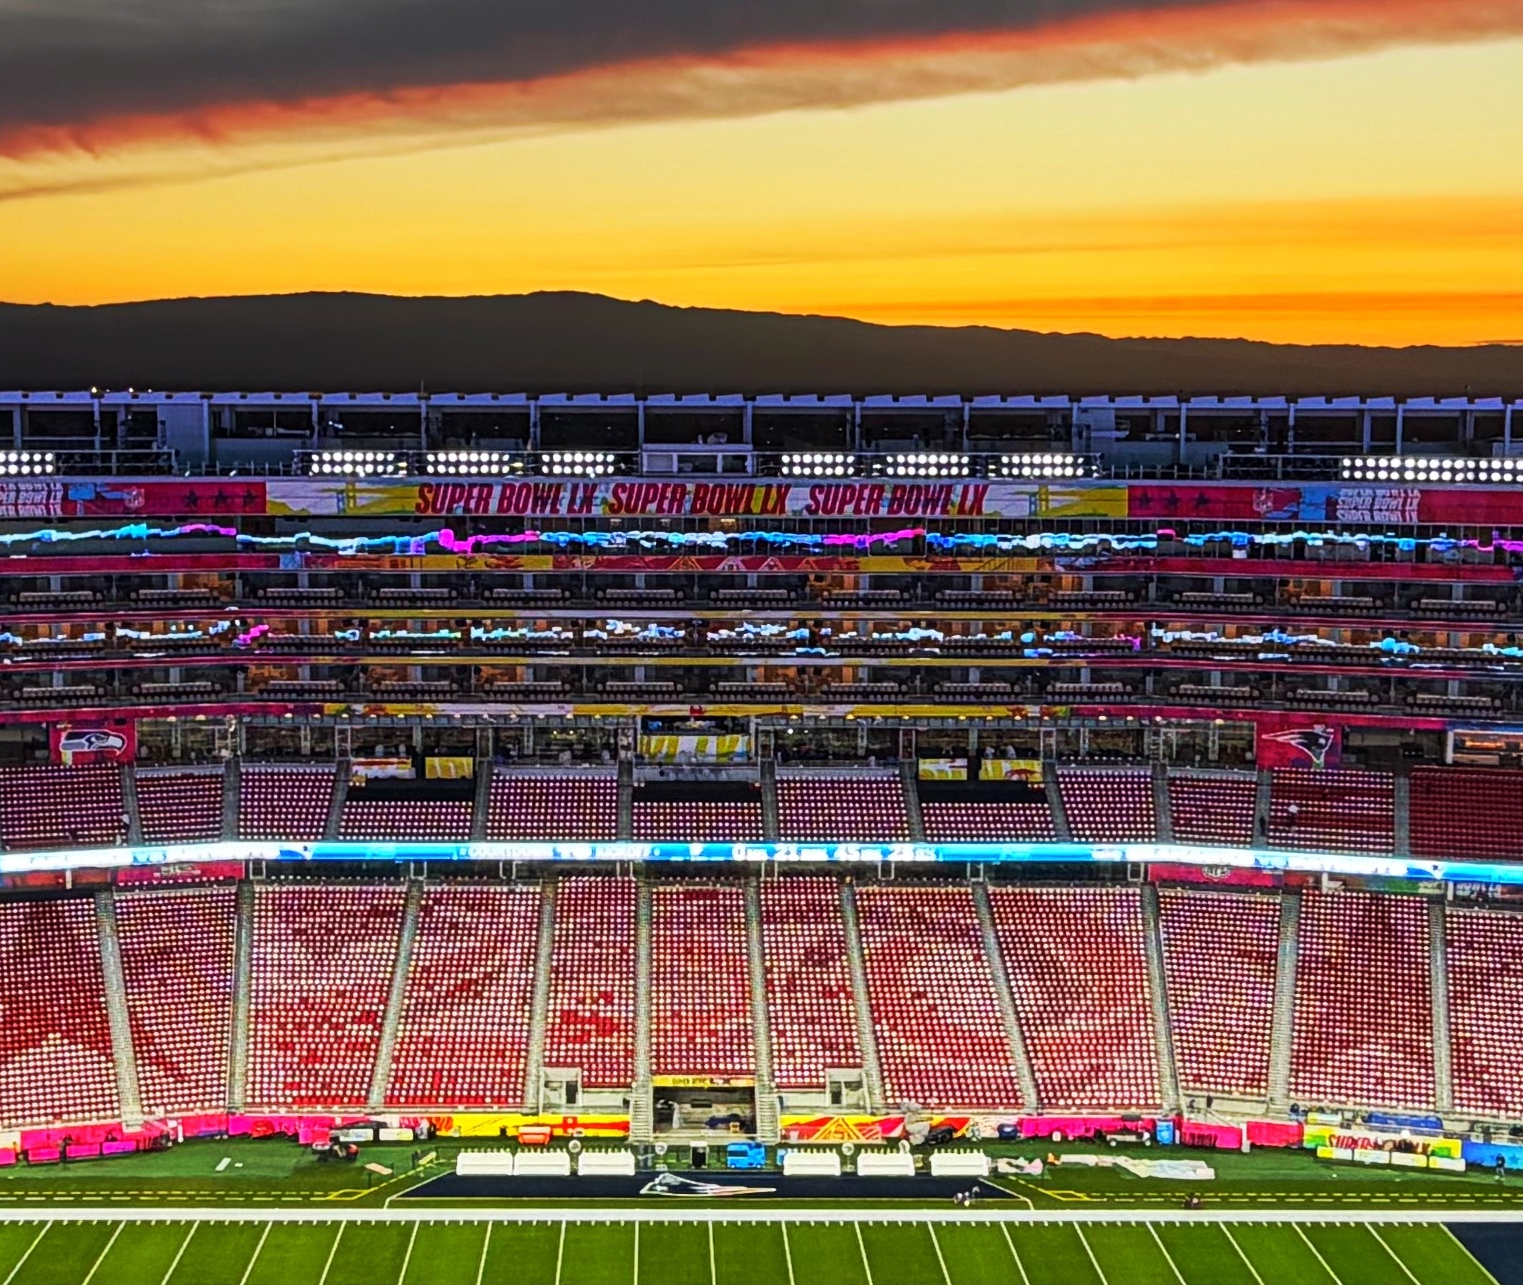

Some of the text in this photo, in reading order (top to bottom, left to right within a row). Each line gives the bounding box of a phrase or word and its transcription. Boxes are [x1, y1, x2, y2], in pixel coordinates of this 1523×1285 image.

[415, 483, 598, 514] SUPER BOWL LX
[608, 483, 792, 514] SUPER BOWL LX
[805, 484, 989, 515] SUPER BOWL LX
